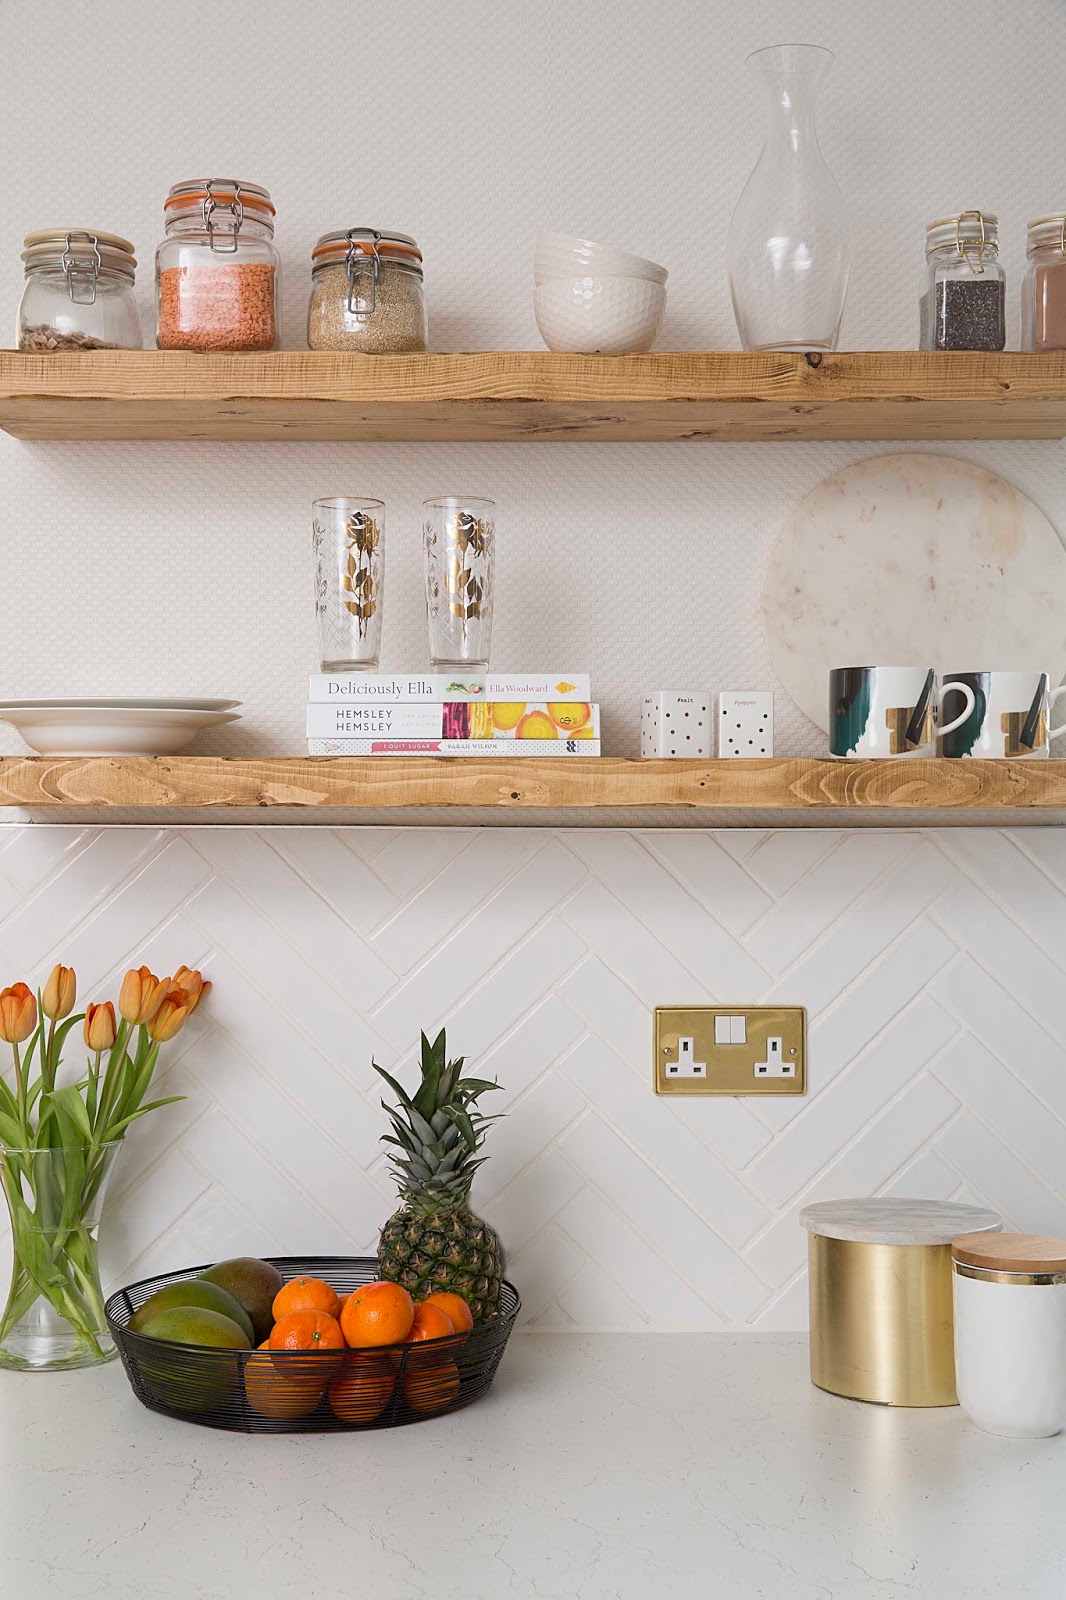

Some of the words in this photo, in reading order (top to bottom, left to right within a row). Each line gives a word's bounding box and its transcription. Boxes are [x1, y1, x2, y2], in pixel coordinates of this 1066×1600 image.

[328, 681, 403, 700] Deliciously
[408, 681, 433, 695] Ella
[489, 684, 505, 693] Ella
[505, 684, 549, 693] Woodward
[336, 710, 393, 719] HEMSLEY
[336, 722, 393, 731] HEMSLEY
